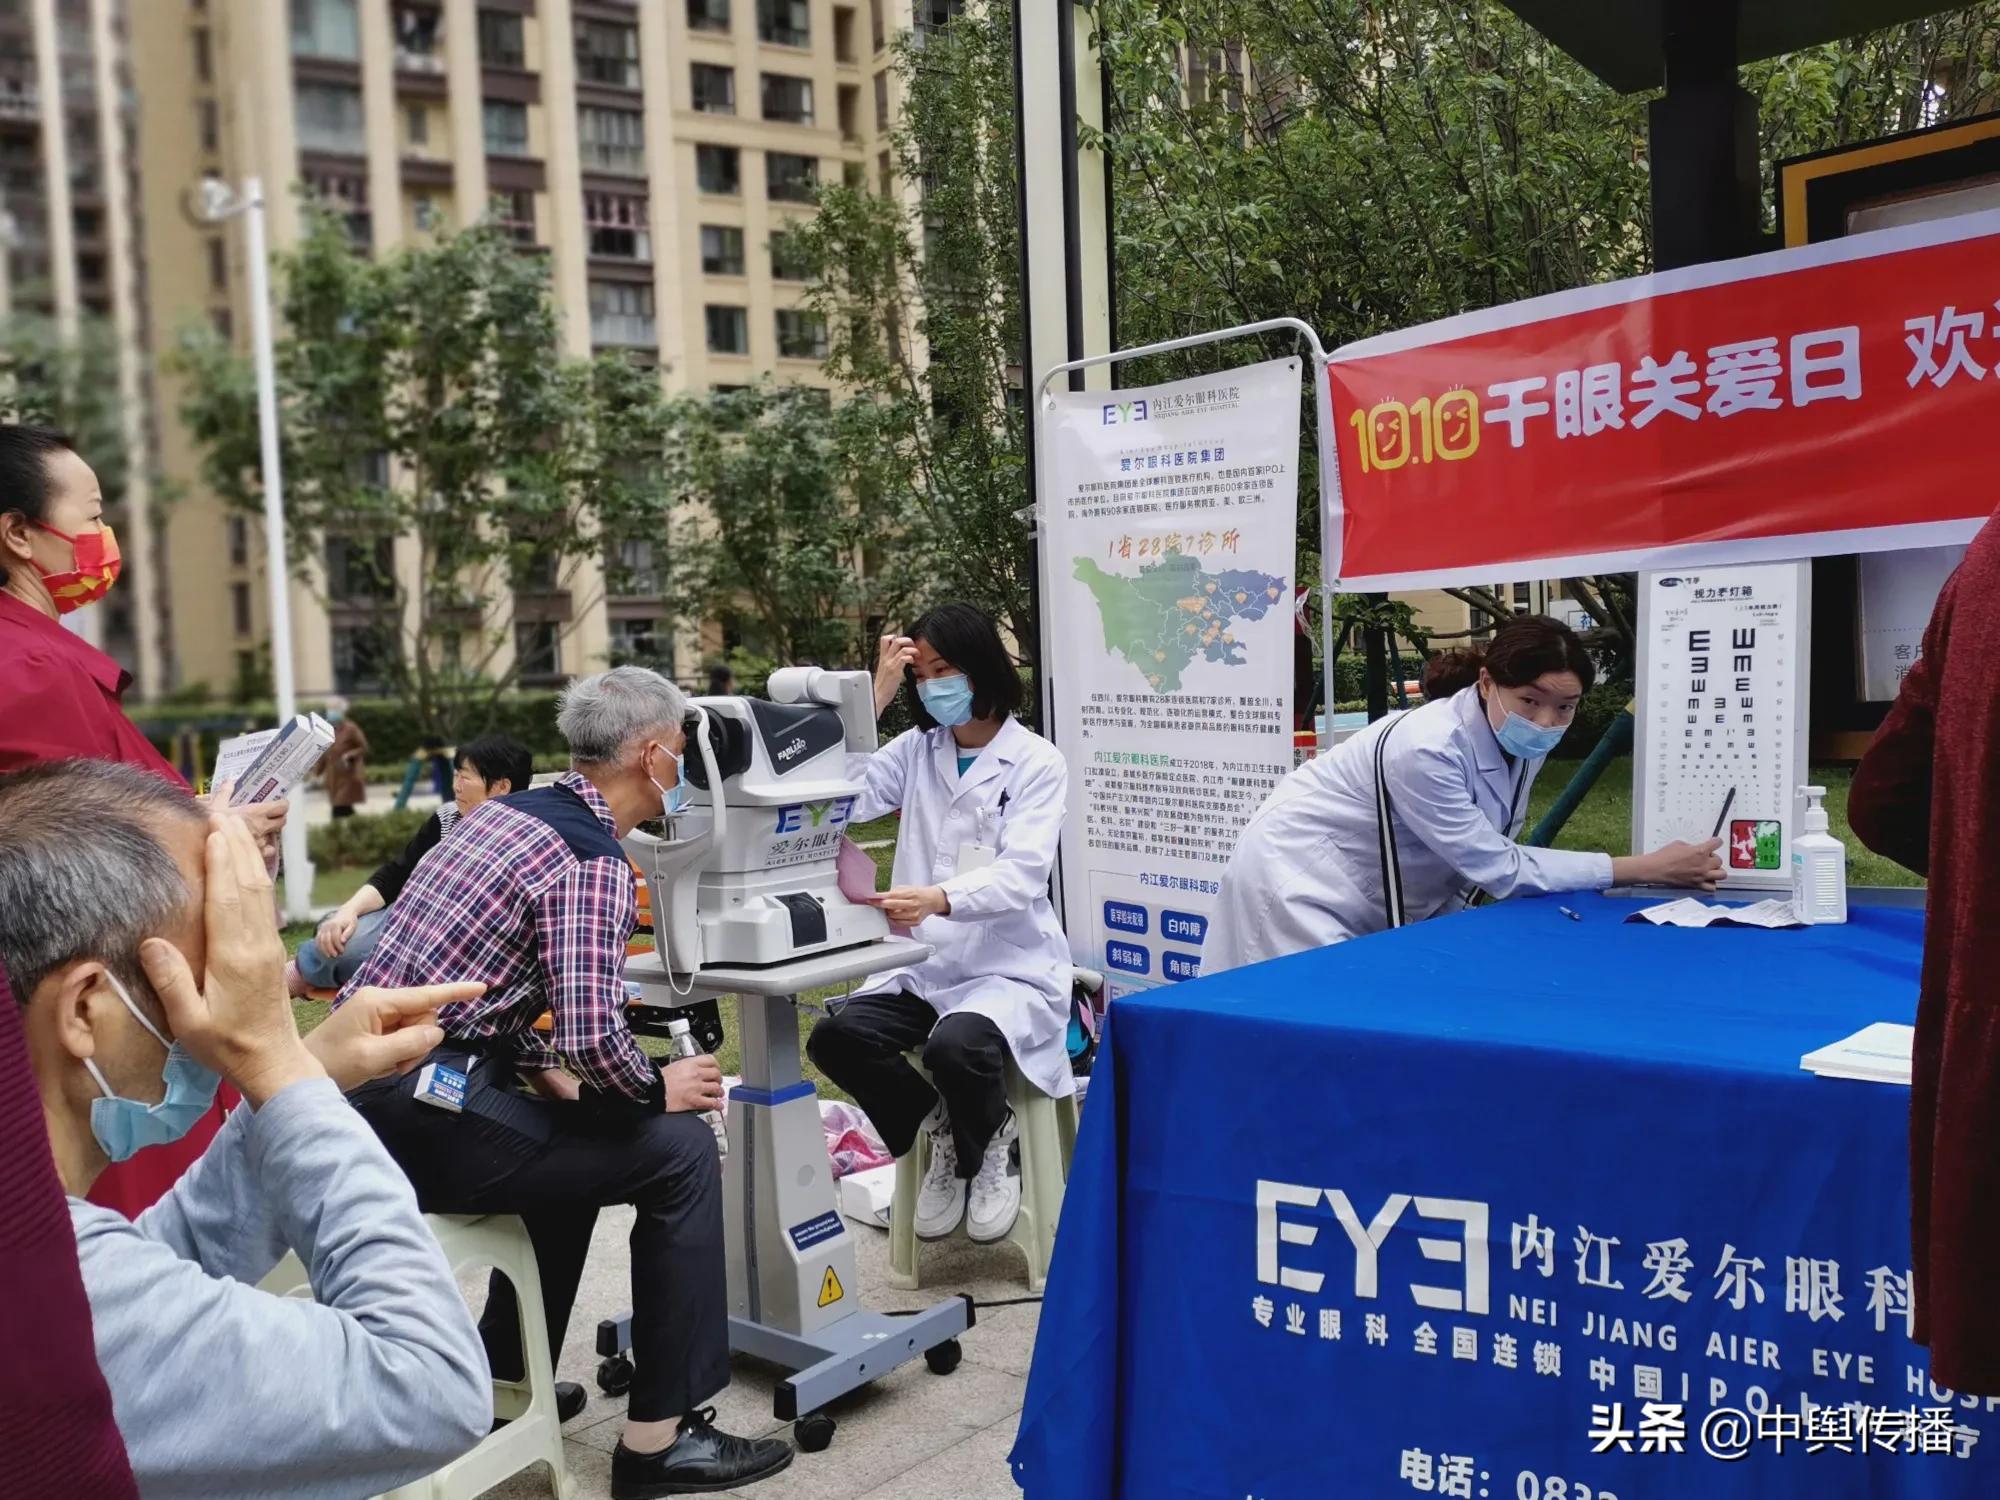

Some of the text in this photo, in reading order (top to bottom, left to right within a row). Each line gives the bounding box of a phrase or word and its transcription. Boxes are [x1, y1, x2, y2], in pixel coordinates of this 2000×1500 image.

[1904, 298, 2000, 389] 欢
[1153, 387, 1240, 411] 内江爱尔眼科医院
[1120, 448, 1225, 472] 爱尔眼科医院集团
[1693, 585, 1753, 599] 视力表灯箱
[1168, 919, 1201, 937] 白内障
[1112, 947, 1143, 967] 斜弱视
[1509, 1294, 1558, 1327] NEI
[1582, 1311, 1678, 1352] JIANG
[1705, 1331, 1781, 1371] AIER
[1812, 1348, 1875, 1384] EYE
